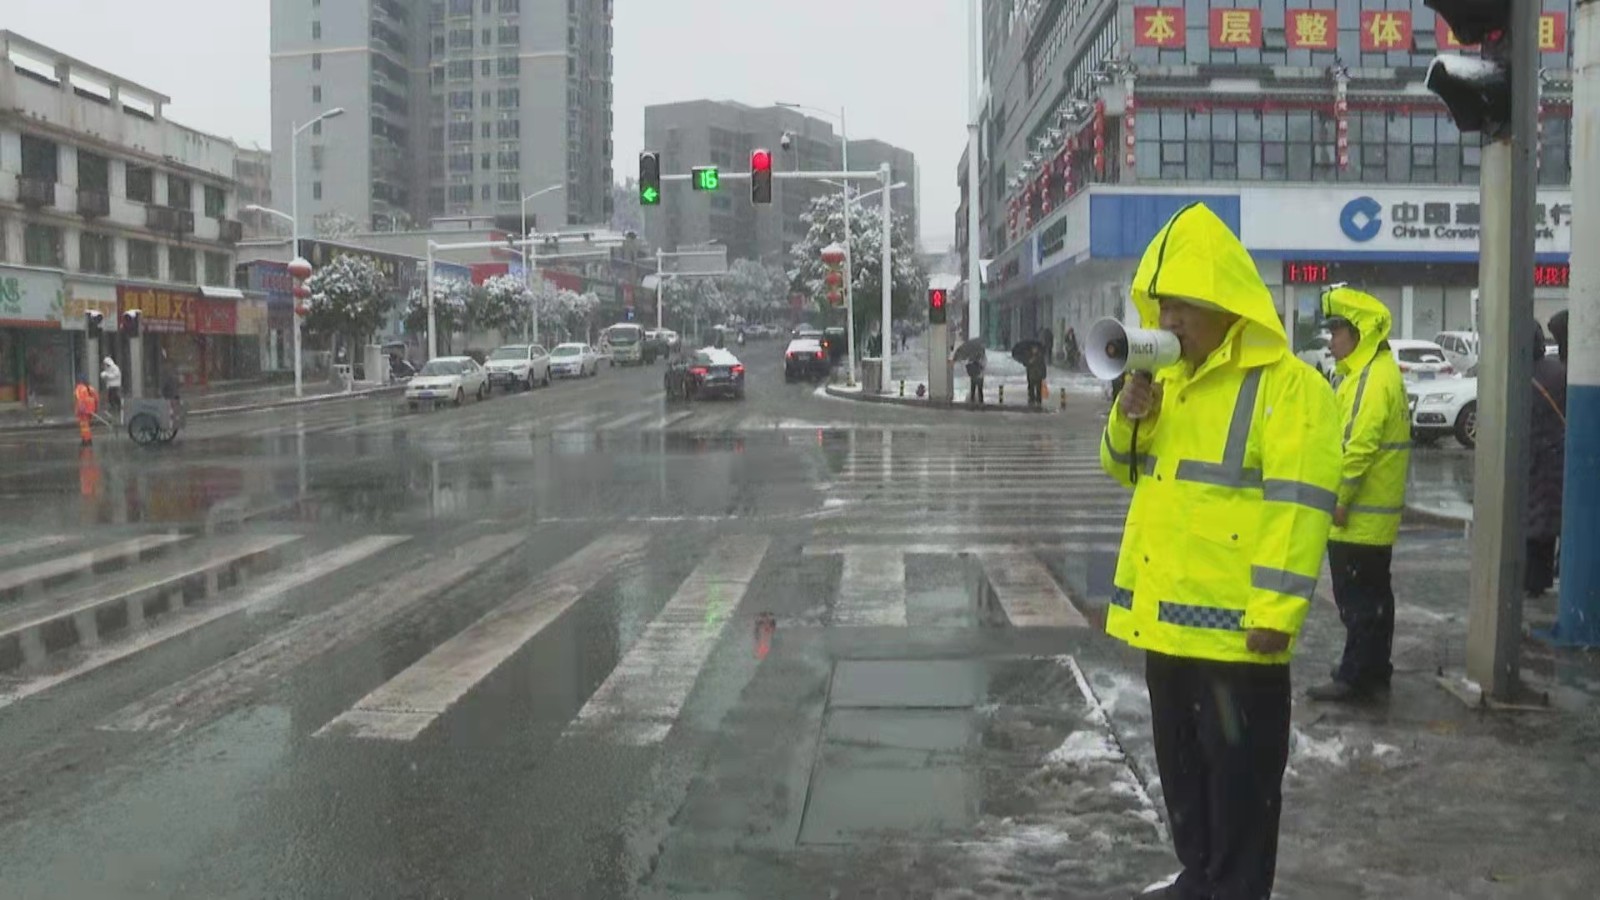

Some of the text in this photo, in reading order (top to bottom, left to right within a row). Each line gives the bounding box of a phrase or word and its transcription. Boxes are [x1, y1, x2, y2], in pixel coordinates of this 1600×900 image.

[701, 170, 717, 189] 16
[1392, 202, 1571, 226] 中国建行
[1393, 226, 1430, 238] China
[1434, 226, 1480, 238] Constr
